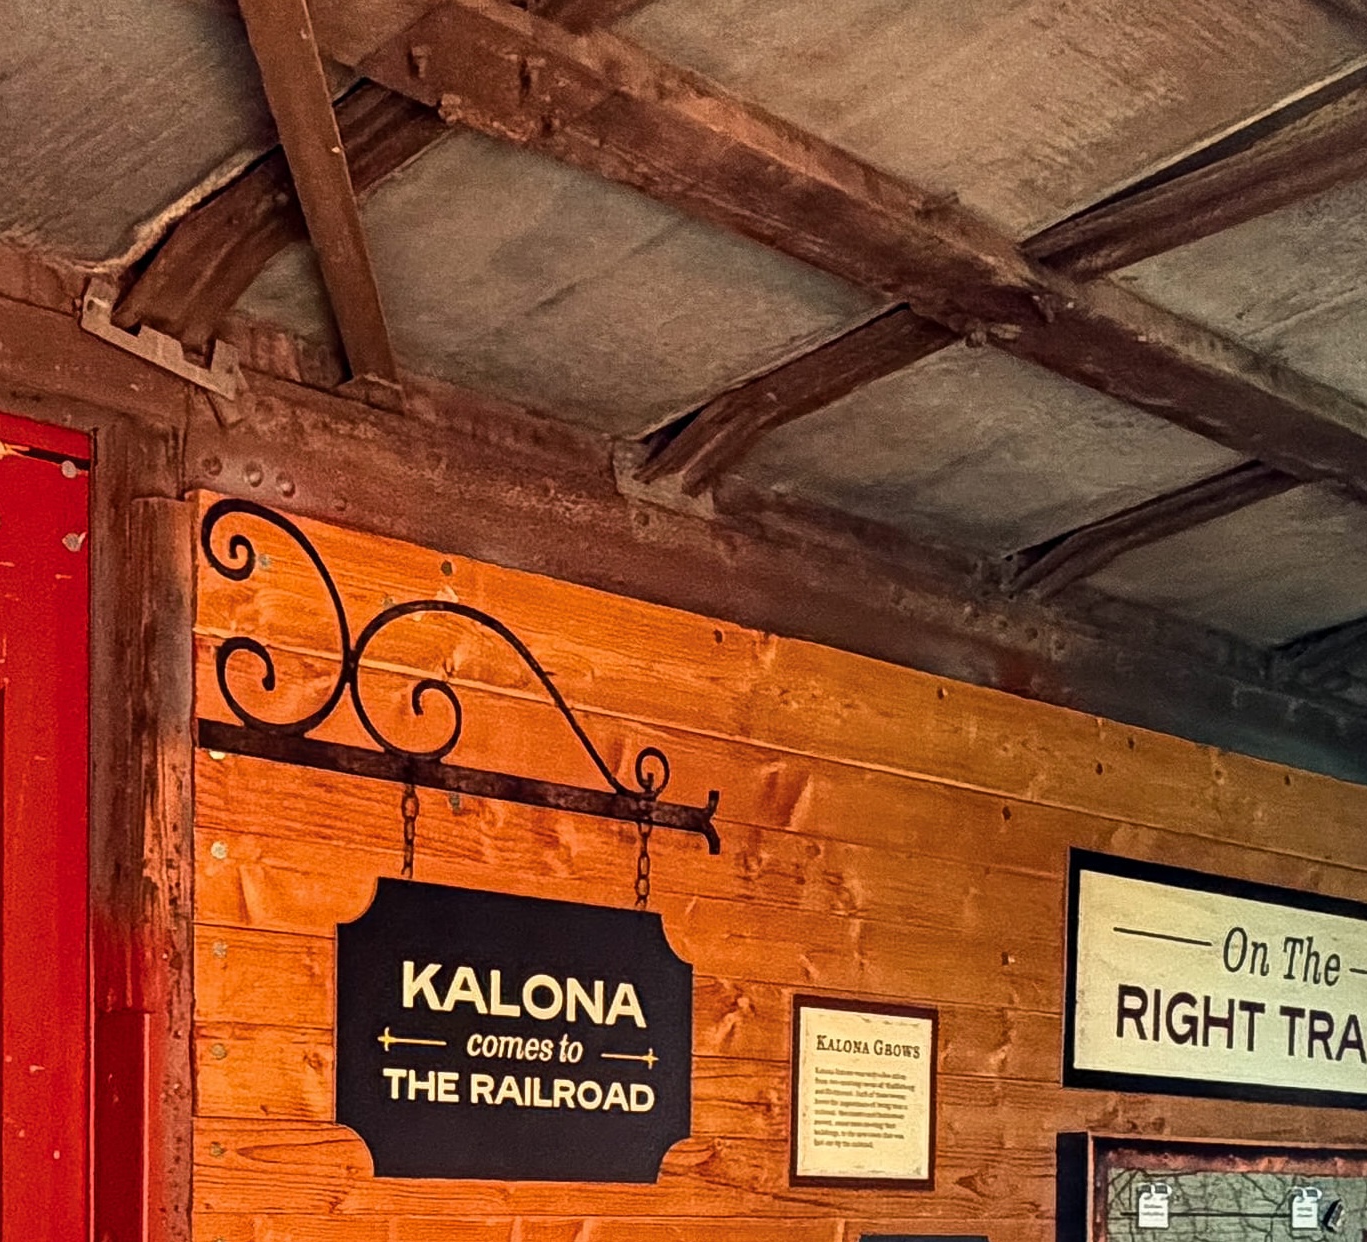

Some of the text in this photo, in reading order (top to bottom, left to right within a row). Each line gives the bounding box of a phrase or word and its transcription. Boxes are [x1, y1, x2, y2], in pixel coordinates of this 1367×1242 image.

[1222, 926, 1341, 986] On The
[402, 960, 647, 1029] KALONA
[1116, 984, 1266, 1052] RIGHT
[466, 1033, 584, 1065] comes to
[382, 1067, 656, 1113] THE RAILROAD
